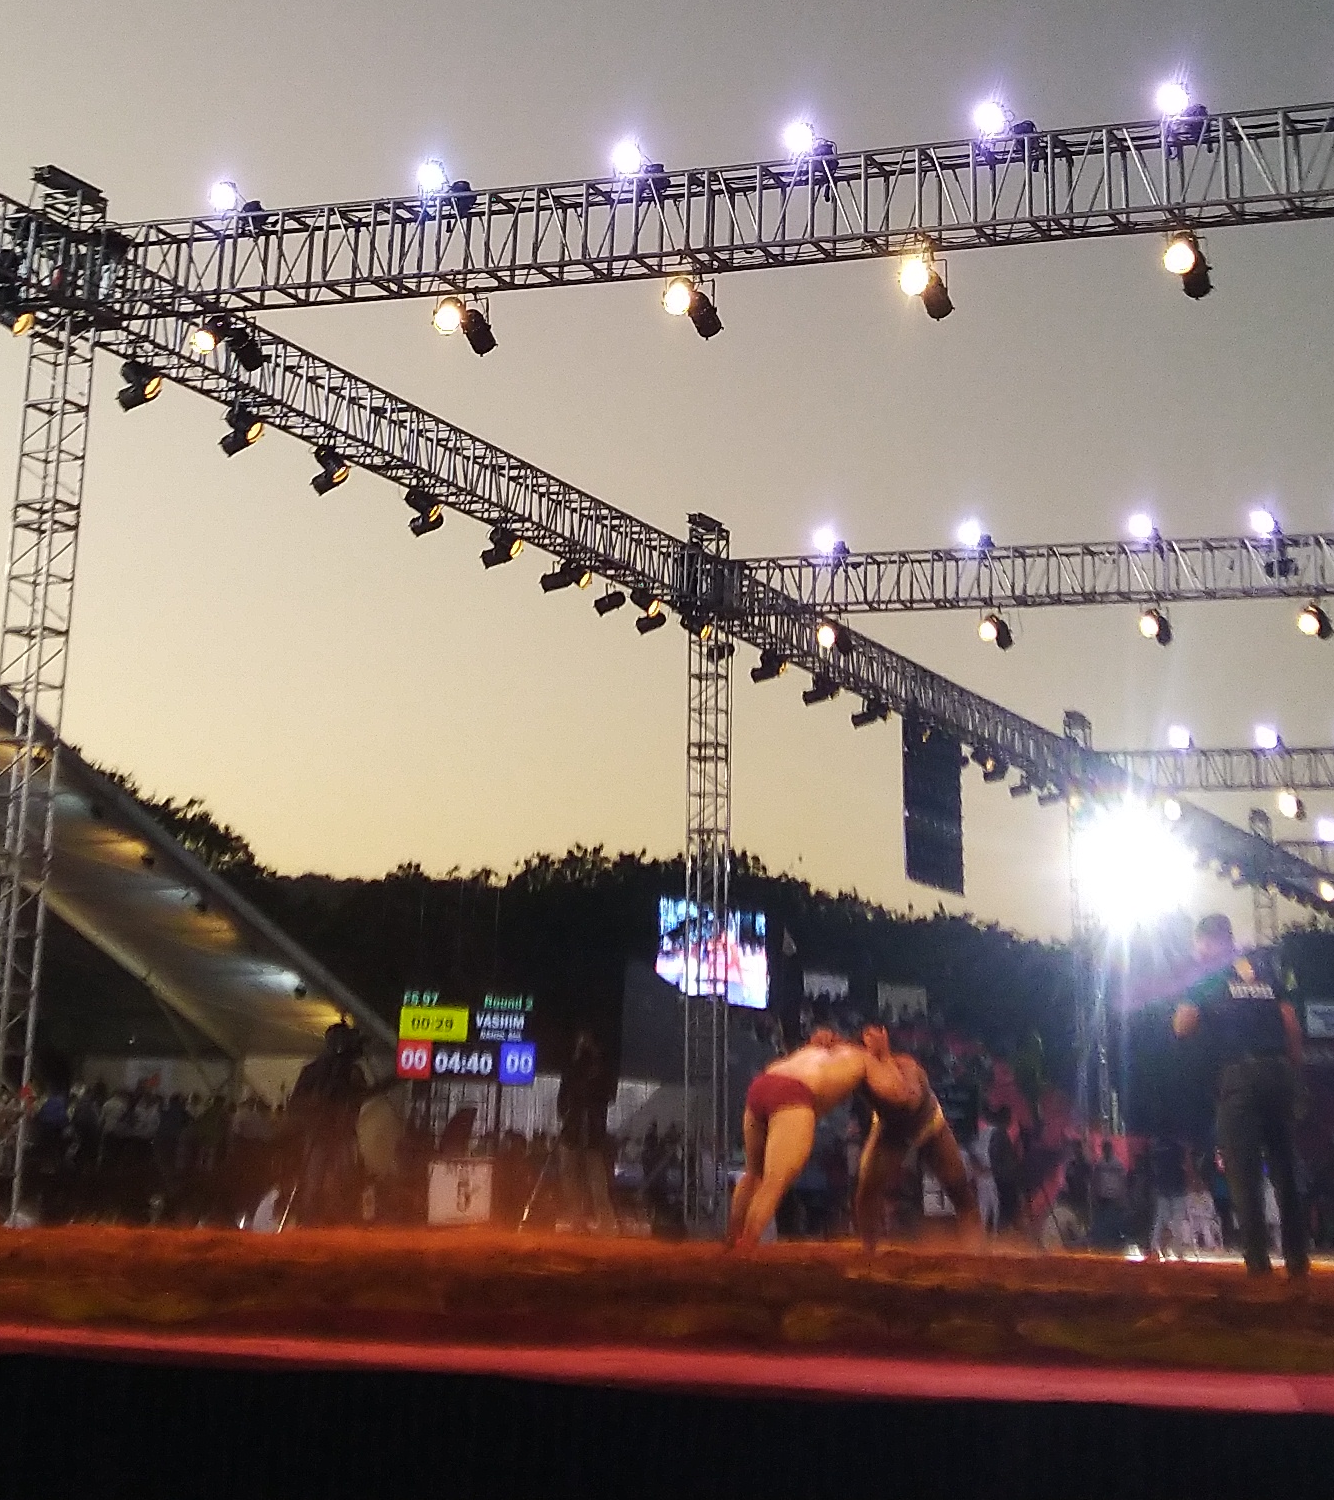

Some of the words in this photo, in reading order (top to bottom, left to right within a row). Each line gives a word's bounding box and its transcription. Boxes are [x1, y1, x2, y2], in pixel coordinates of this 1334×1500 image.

[401, 1048, 427, 1070] 00
[434, 1049, 493, 1075] 04:40
[506, 1051, 533, 1074] 00
